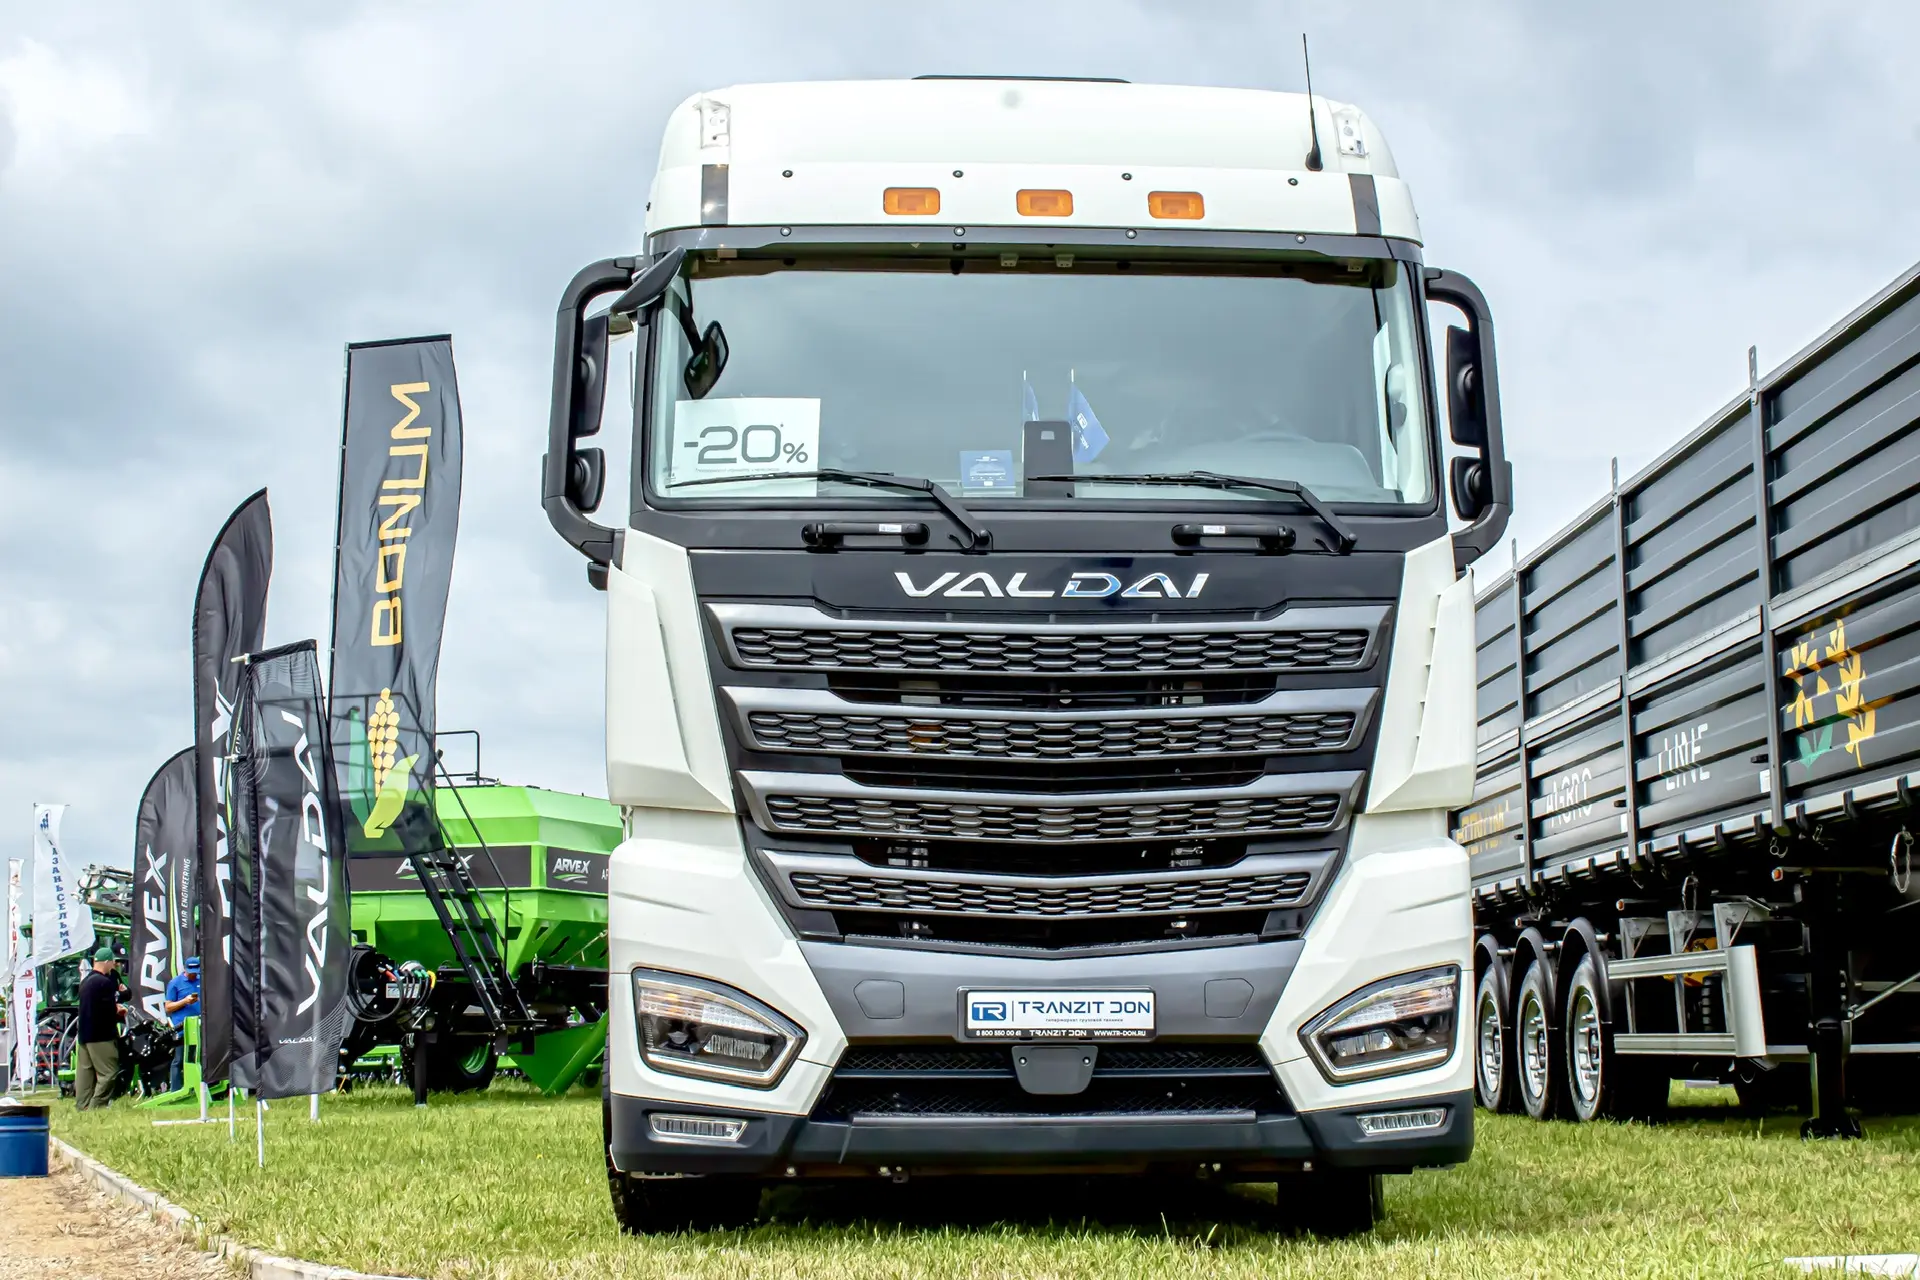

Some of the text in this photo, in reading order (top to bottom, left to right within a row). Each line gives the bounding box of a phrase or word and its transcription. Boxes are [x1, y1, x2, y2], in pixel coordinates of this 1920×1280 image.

[370, 381, 431, 647] BONUM
[894, 571, 1210, 598] VALDAI
[1657, 722, 1711, 791] LINE
[181, 857, 192, 906] ENGINEERING
[280, 709, 330, 1017] VALDAI
[552, 857, 592, 875] ARVEX
[140, 843, 168, 1027] ARVEX
[973, 1003, 1006, 1020] TR
[1018, 1001, 1150, 1014] TRANZIT DON
